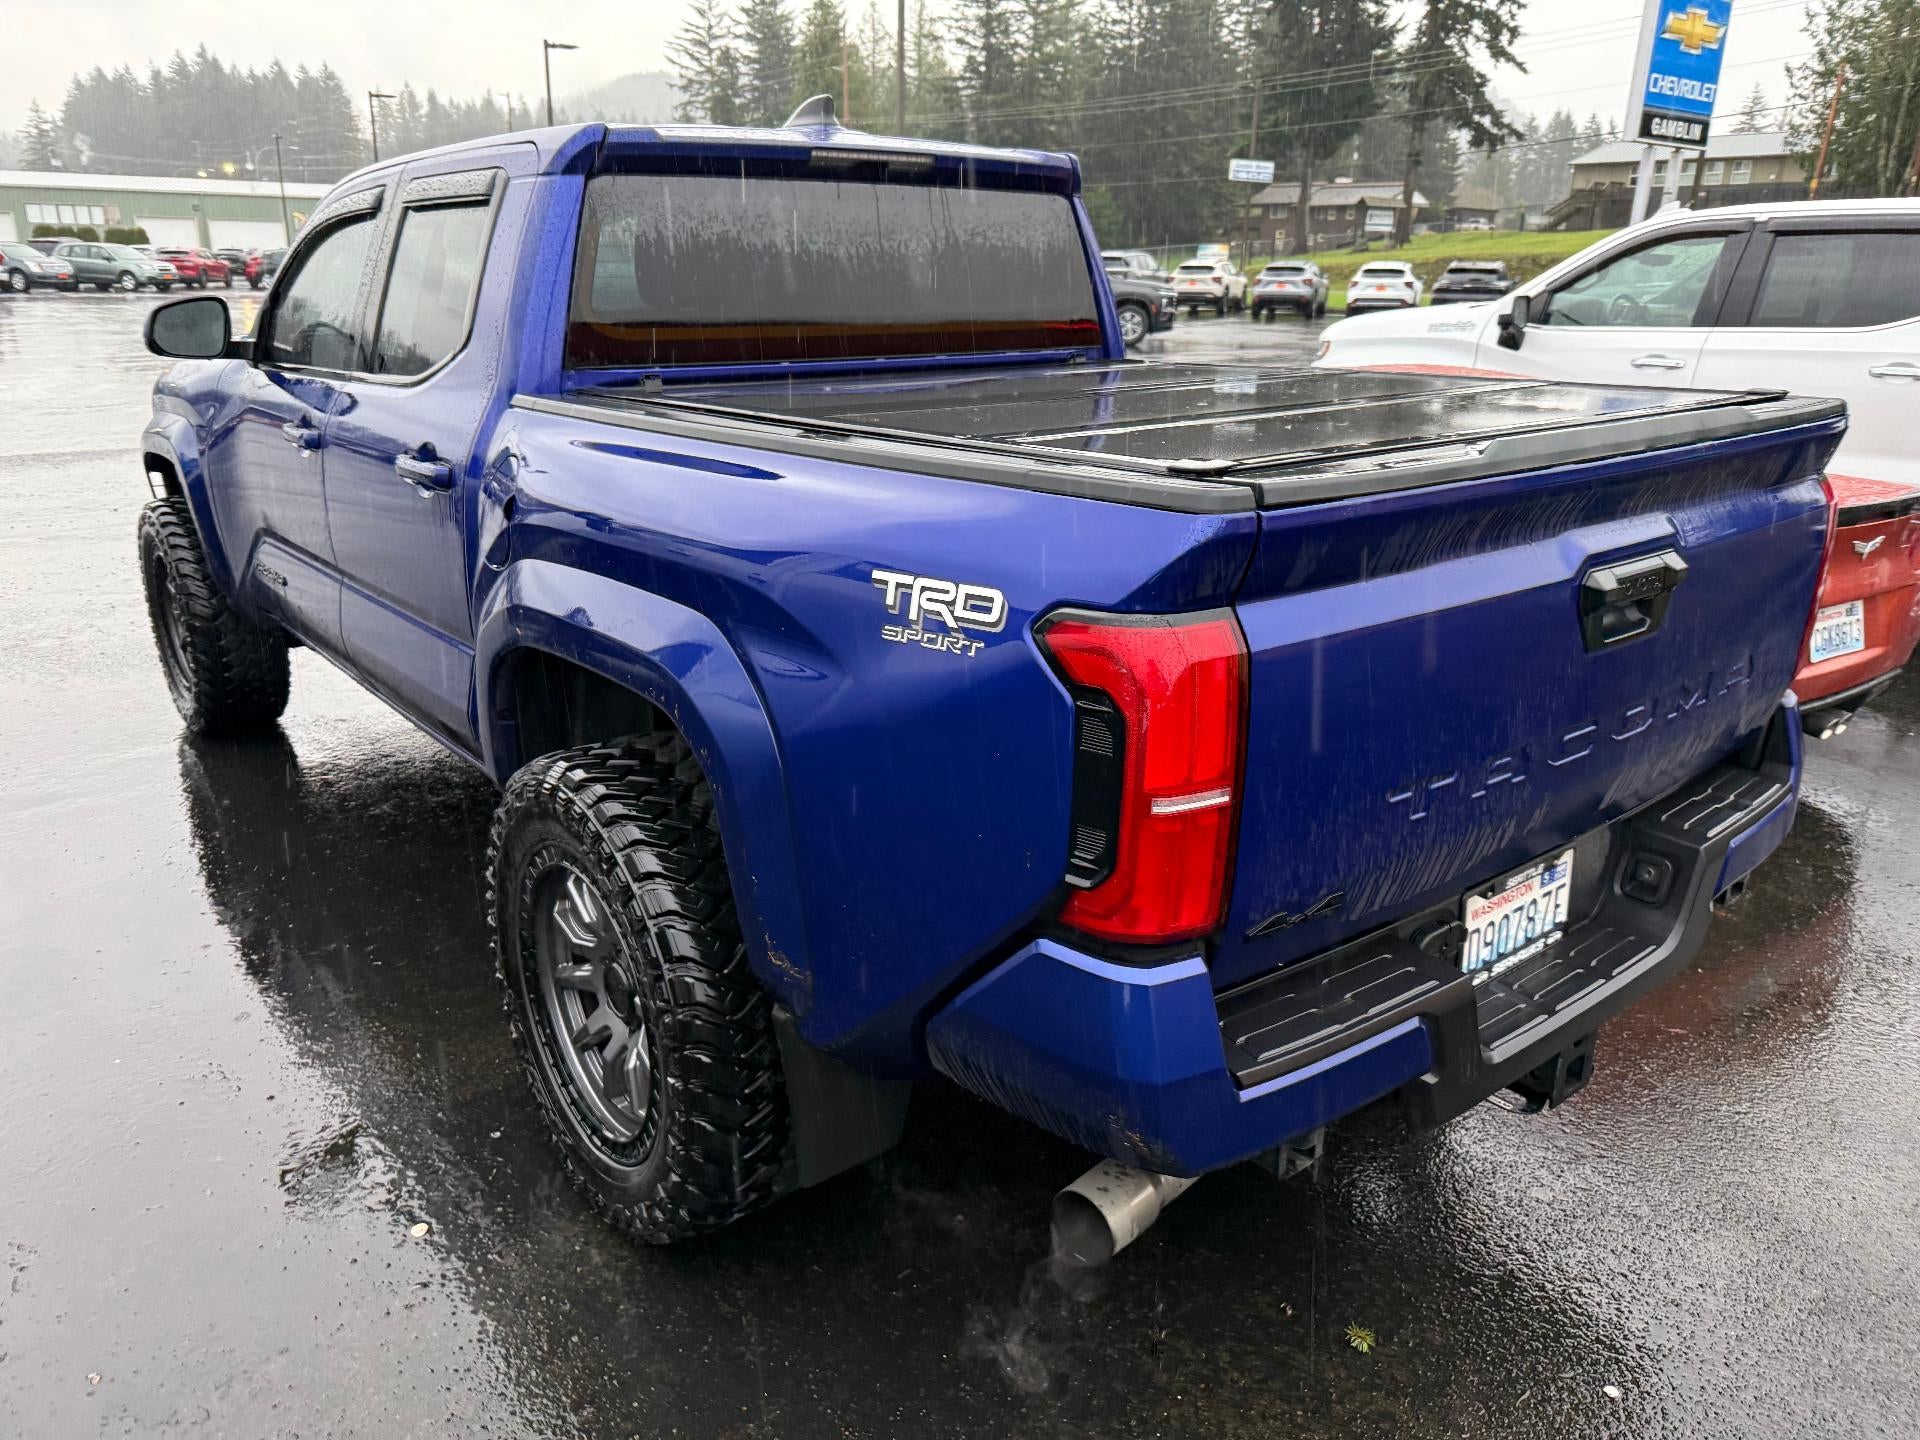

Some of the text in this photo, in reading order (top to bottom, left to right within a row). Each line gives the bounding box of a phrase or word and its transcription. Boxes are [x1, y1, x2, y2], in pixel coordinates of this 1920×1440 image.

[1649, 72, 1716, 103] CHEVROLET
[1651, 117, 1703, 141] GAMBLIN
[871, 569, 1006, 632] TRD
[881, 625, 985, 658] SPORT
[1385, 653, 1753, 821] TACOMA
[1470, 881, 1535, 922] WASHINGTON
